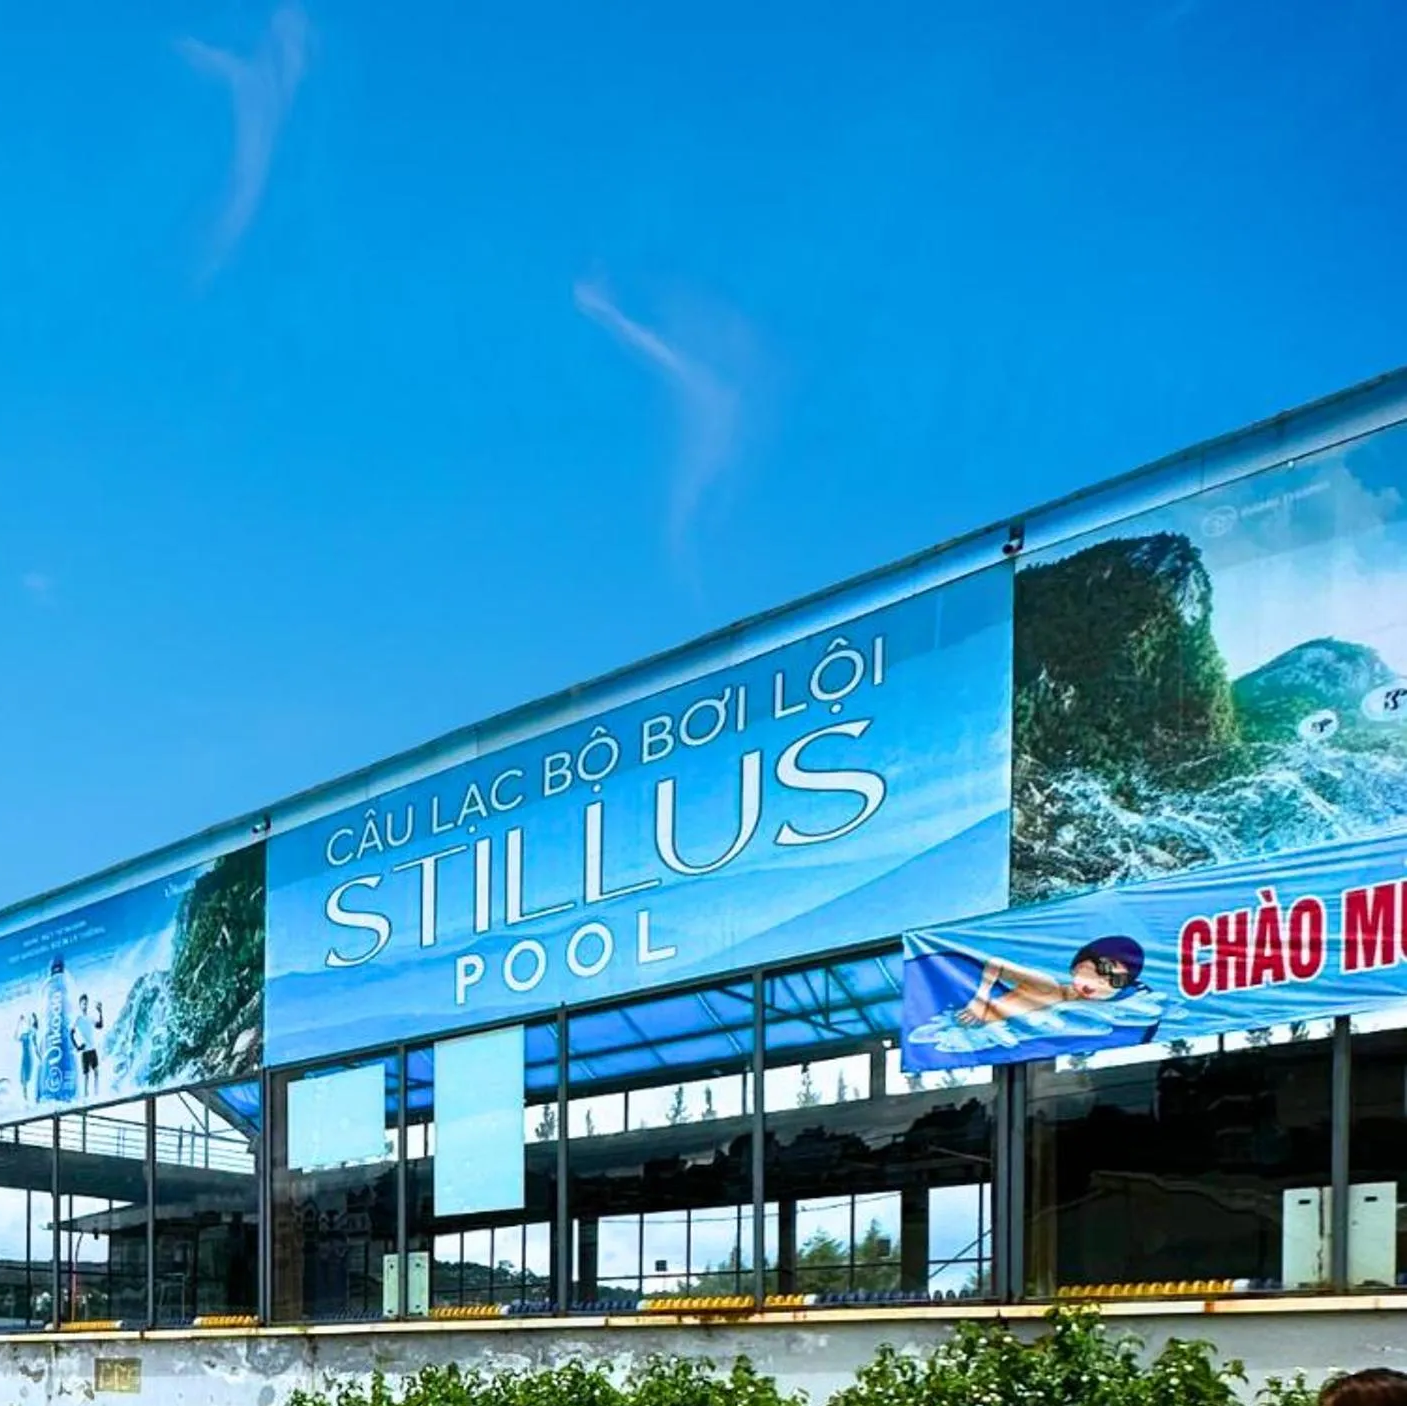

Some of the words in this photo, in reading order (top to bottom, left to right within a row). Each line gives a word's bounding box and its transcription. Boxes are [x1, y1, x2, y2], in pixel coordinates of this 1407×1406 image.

[326, 803, 414, 866] CÂU
[430, 768, 524, 834] LẠC
[542, 725, 621, 798] BỘ
[641, 685, 746, 765] BƠI
[773, 635, 884, 720] LỘI
[325, 718, 888, 968] STILLUS
[455, 908, 678, 1006] POOL
[1179, 886, 1326, 998] CHÀO
[1342, 879, 1407, 972] M
